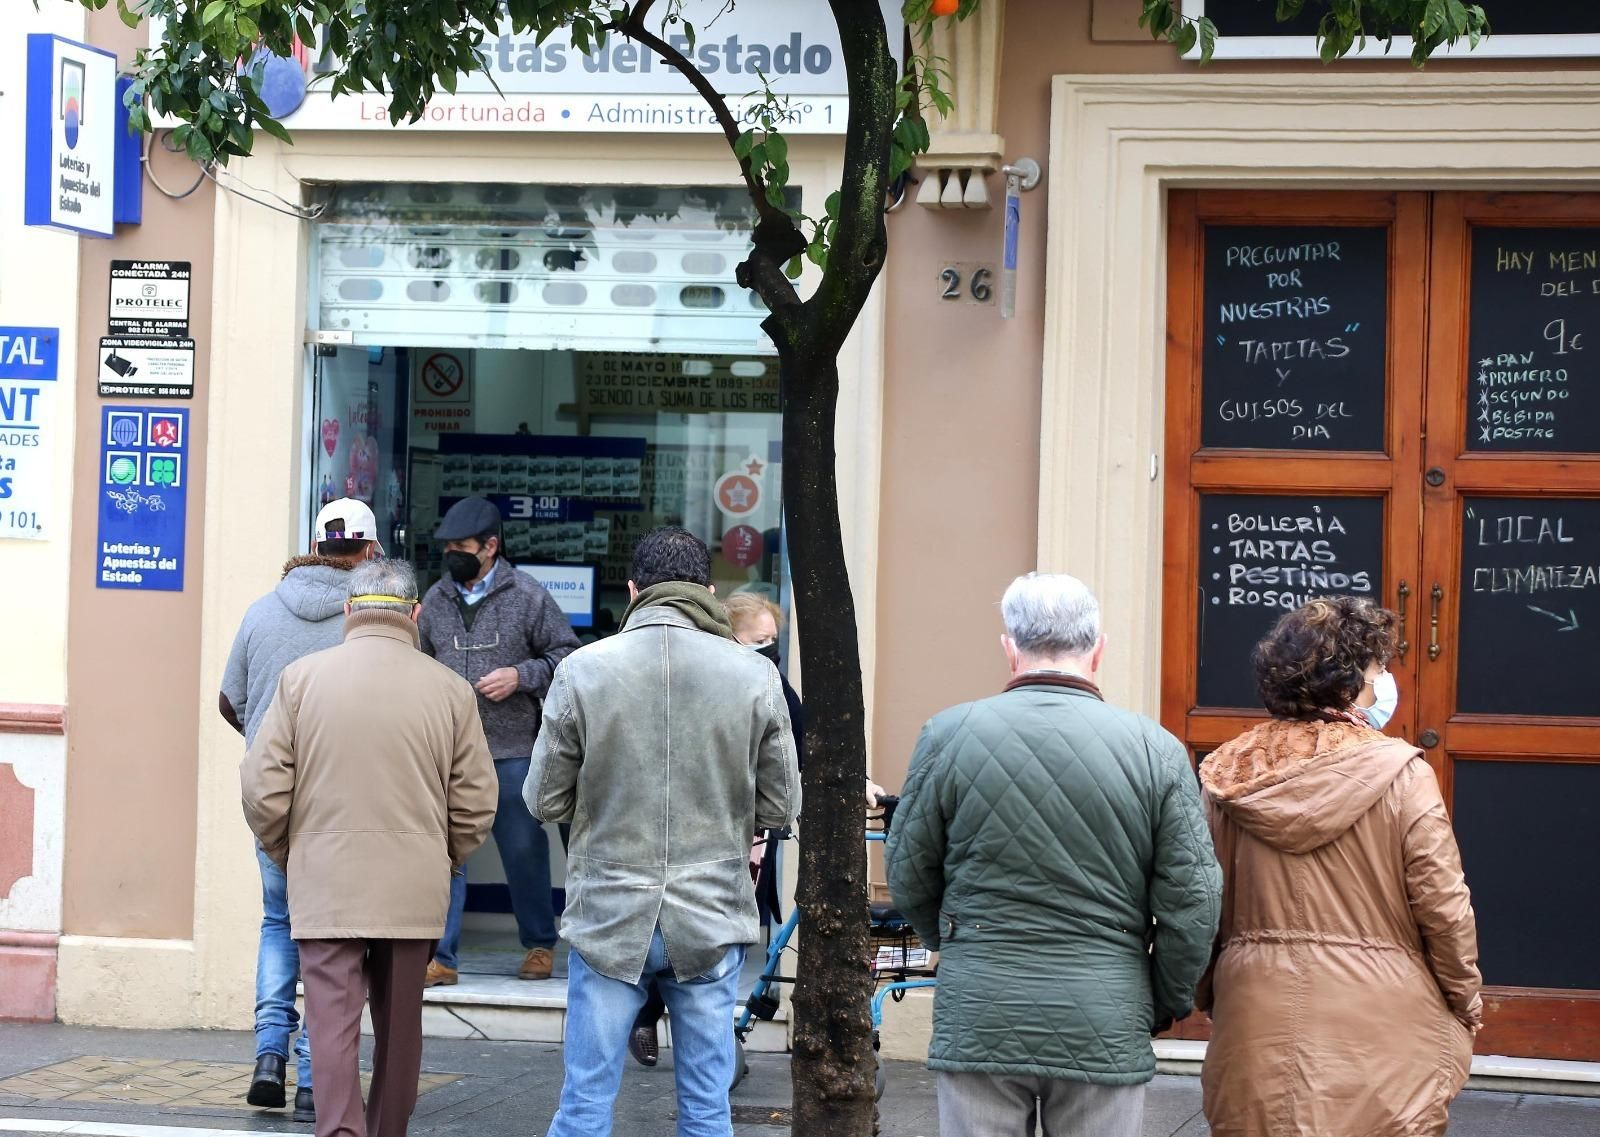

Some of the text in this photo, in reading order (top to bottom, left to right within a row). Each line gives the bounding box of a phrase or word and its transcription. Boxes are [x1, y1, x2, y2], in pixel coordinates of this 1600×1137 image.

[582, 32, 651, 74] del
[668, 32, 833, 75] Estado
[361, 101, 545, 122] La fortunada
[587, 102, 775, 125] Administraión
[824, 104, 833, 124] 1
[86, 163, 91, 178] y
[59, 174, 101, 197] Apuestas del
[59, 195, 82, 214] Estado
[1226, 242, 1341, 267] PREGUNTAR
[1496, 247, 1600, 274] HAY MEN
[111, 270, 167, 278] CONECTADA
[1267, 268, 1303, 288] POR
[940, 267, 992, 301] 26
[1540, 280, 1581, 296] DEL
[115, 298, 183, 307] PROTELEC
[1220, 297, 1331, 323] NUESTRAS
[155, 321, 187, 329] ALARMAS
[123, 339, 178, 347] VIDEOVIGILADA
[621, 361, 665, 373] MAYO
[1497, 351, 1534, 367] PAN
[621, 375, 711, 388] DICIEMBRE
[1489, 368, 1568, 386] PRIMERO
[109, 386, 156, 395] PROTELEC
[637, 391, 654, 406] LA
[660, 391, 694, 408] SUMA
[700, 392, 716, 408] DE
[722, 393, 748, 408] LOS
[752, 393, 778, 409] PRE
[414, 408, 471, 417] PROHIBIDO
[1220, 399, 1353, 421] GUISOS DEL
[424, 422, 461, 431] FUMAR
[103, 542, 160, 557] Loterías y
[1229, 538, 1337, 562] TARTAS
[102, 556, 177, 570] Apuestas del
[102, 570, 142, 583] Estado
[540, 580, 577, 591] VENIDO
